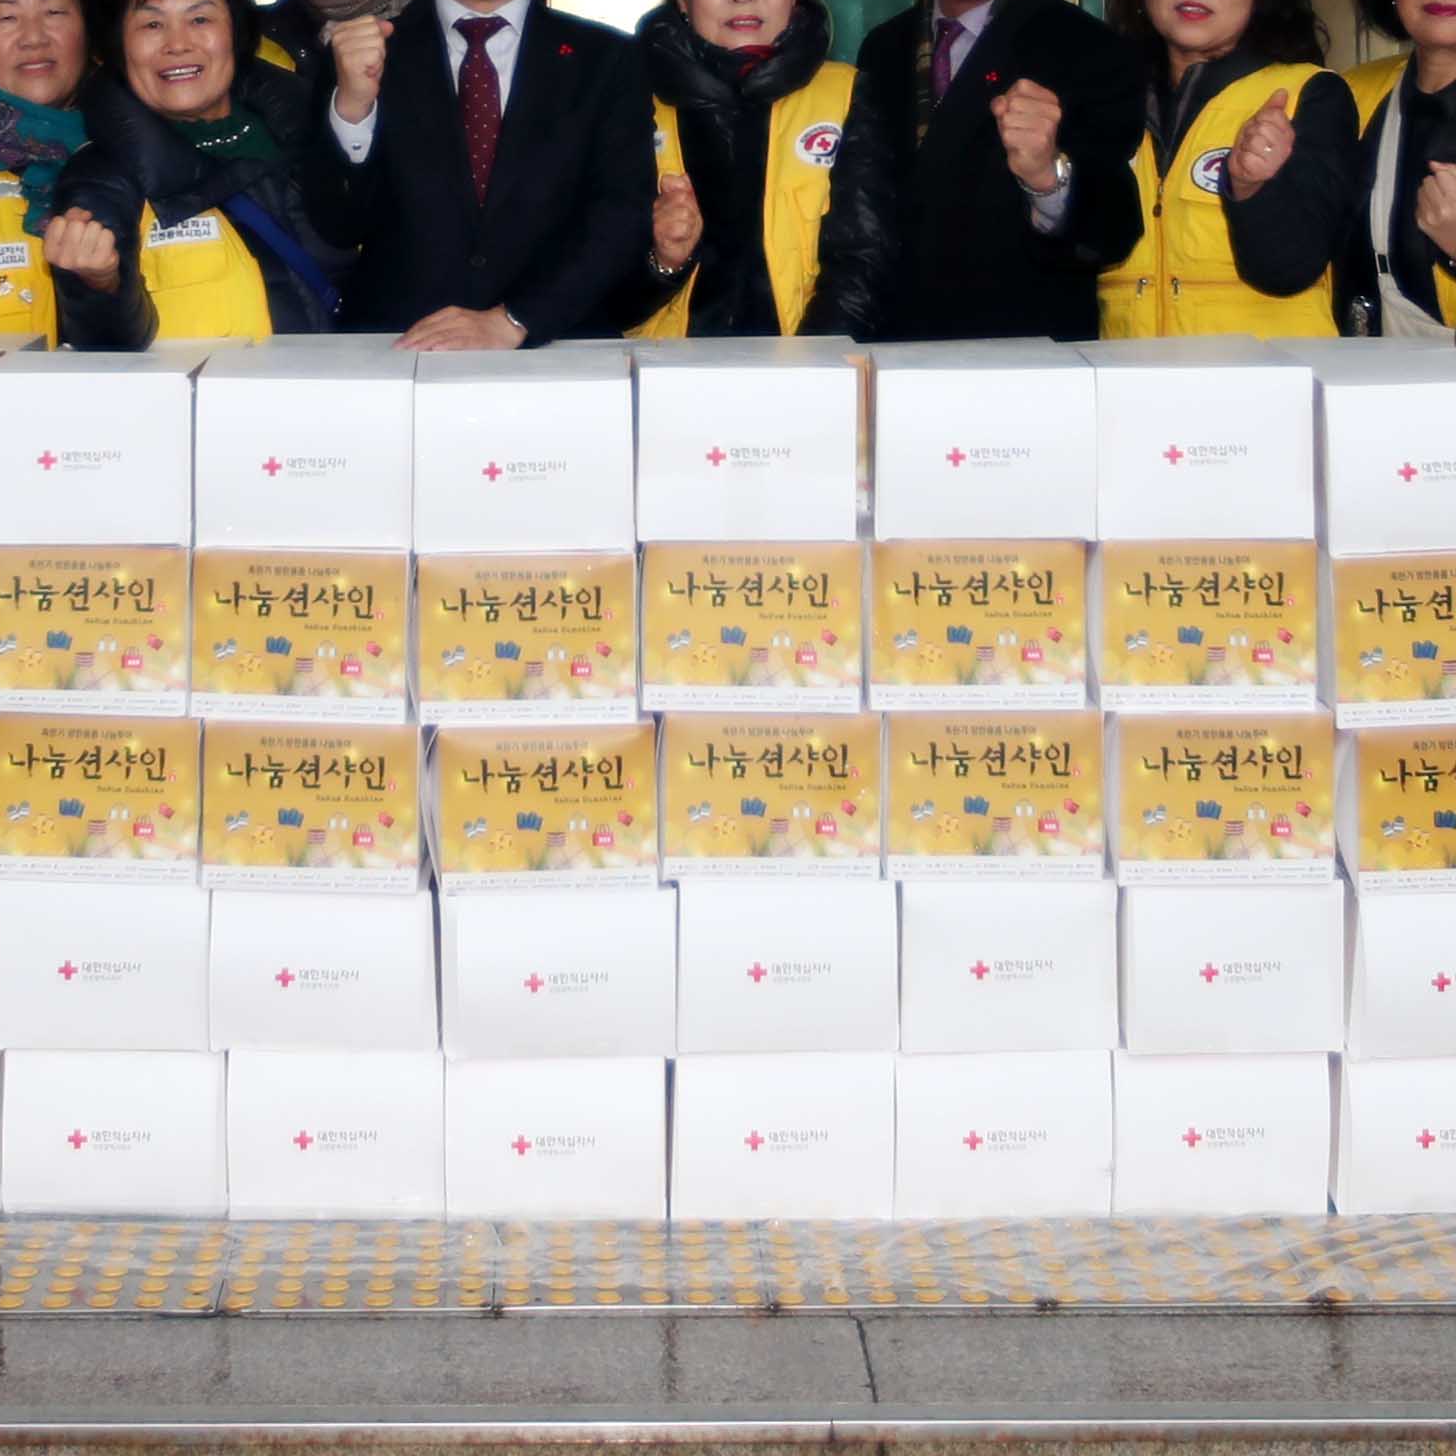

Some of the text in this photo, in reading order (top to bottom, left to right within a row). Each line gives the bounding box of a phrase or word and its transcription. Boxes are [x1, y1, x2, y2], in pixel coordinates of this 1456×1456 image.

[212, 580, 376, 619] 나눔션샤인
[439, 585, 604, 622] 나눔션샤인
[666, 571, 831, 608] 나눔션샤인
[892, 570, 1055, 606] 나눔션샤인
[1123, 571, 1286, 606] 나눔션샤인
[5, 742, 168, 782] 나눔션샤인
[224, 752, 388, 790] 나눔션샤인
[461, 755, 625, 794] 나눔션샤인
[686, 743, 851, 778] 나눔션샤인
[909, 741, 1073, 776] 나눔션샤인
[1141, 744, 1304, 781] 나눔션샤인
